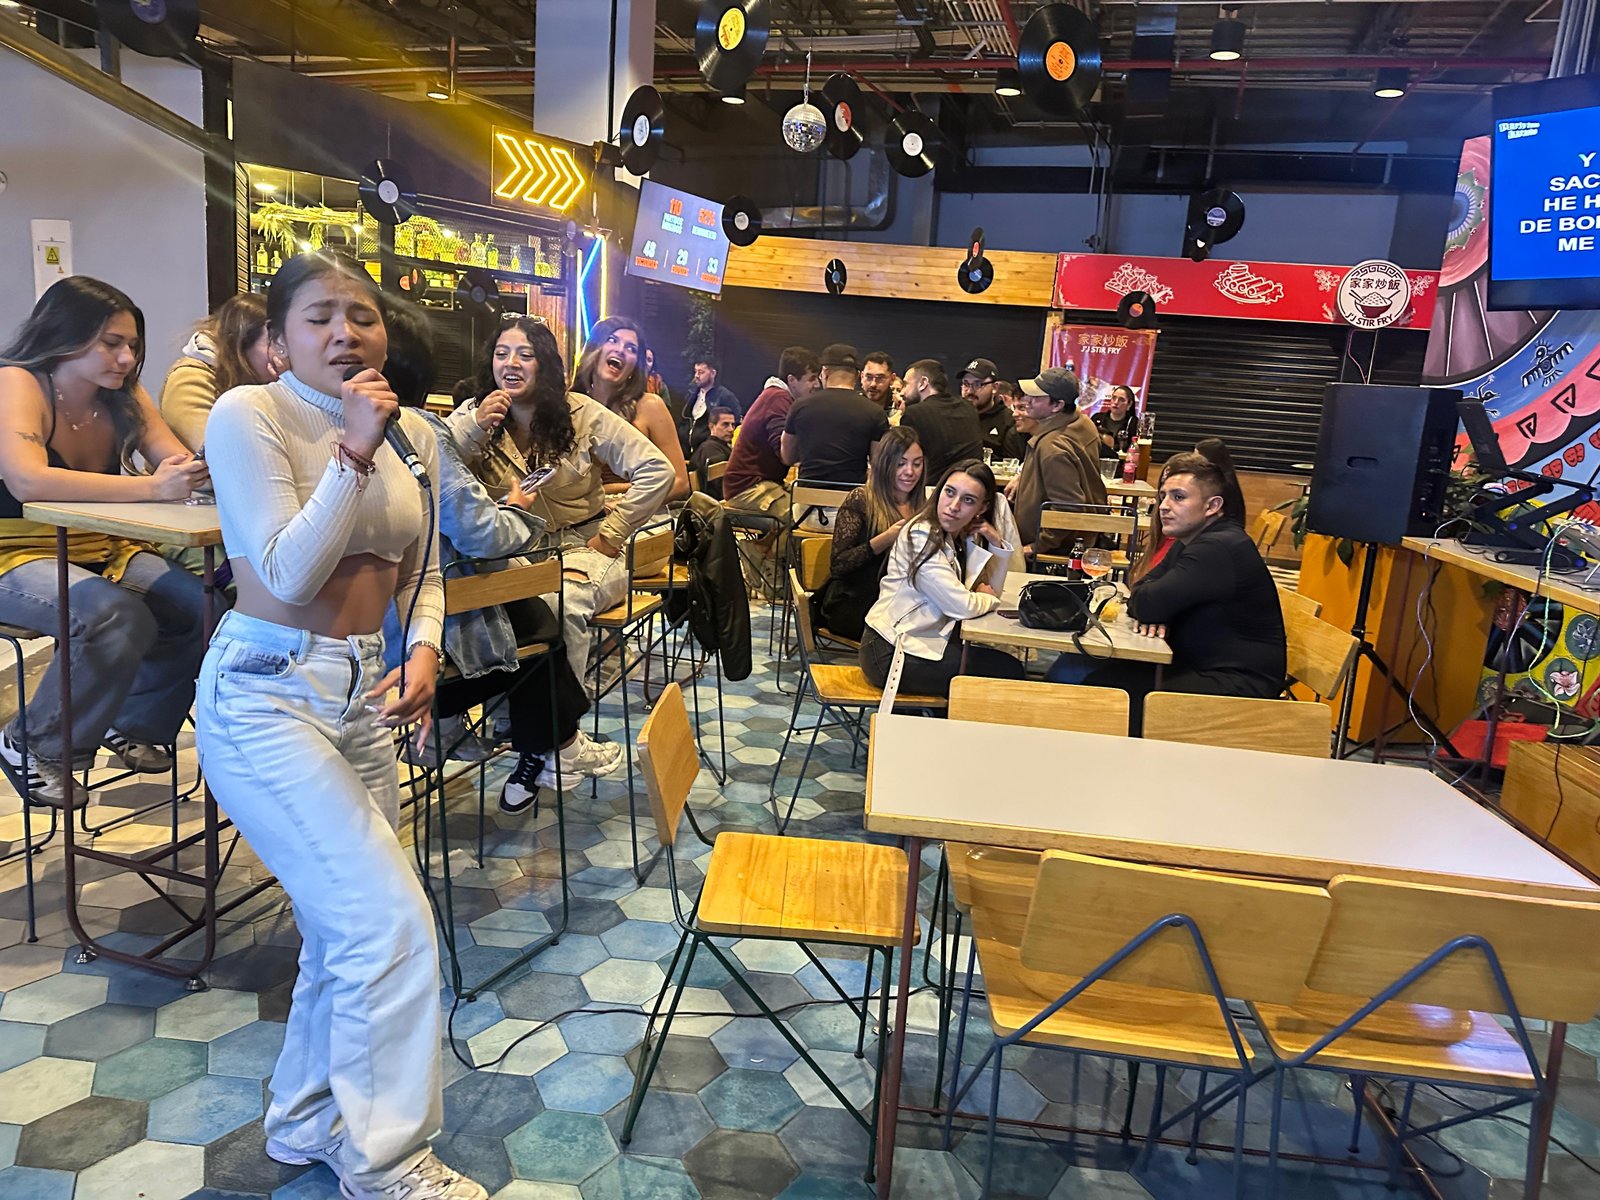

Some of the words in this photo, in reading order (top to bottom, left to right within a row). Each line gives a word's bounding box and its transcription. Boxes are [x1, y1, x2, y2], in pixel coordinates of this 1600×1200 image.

[1578, 152, 1596, 167] Y
[1544, 196, 1577, 212] HE
[1520, 218, 1552, 234] DE
[1558, 236, 1594, 252] ME
[1356, 317, 1375, 327] STIR
[1377, 314, 1393, 326] FRY
[1090, 346, 1107, 354] STIR
